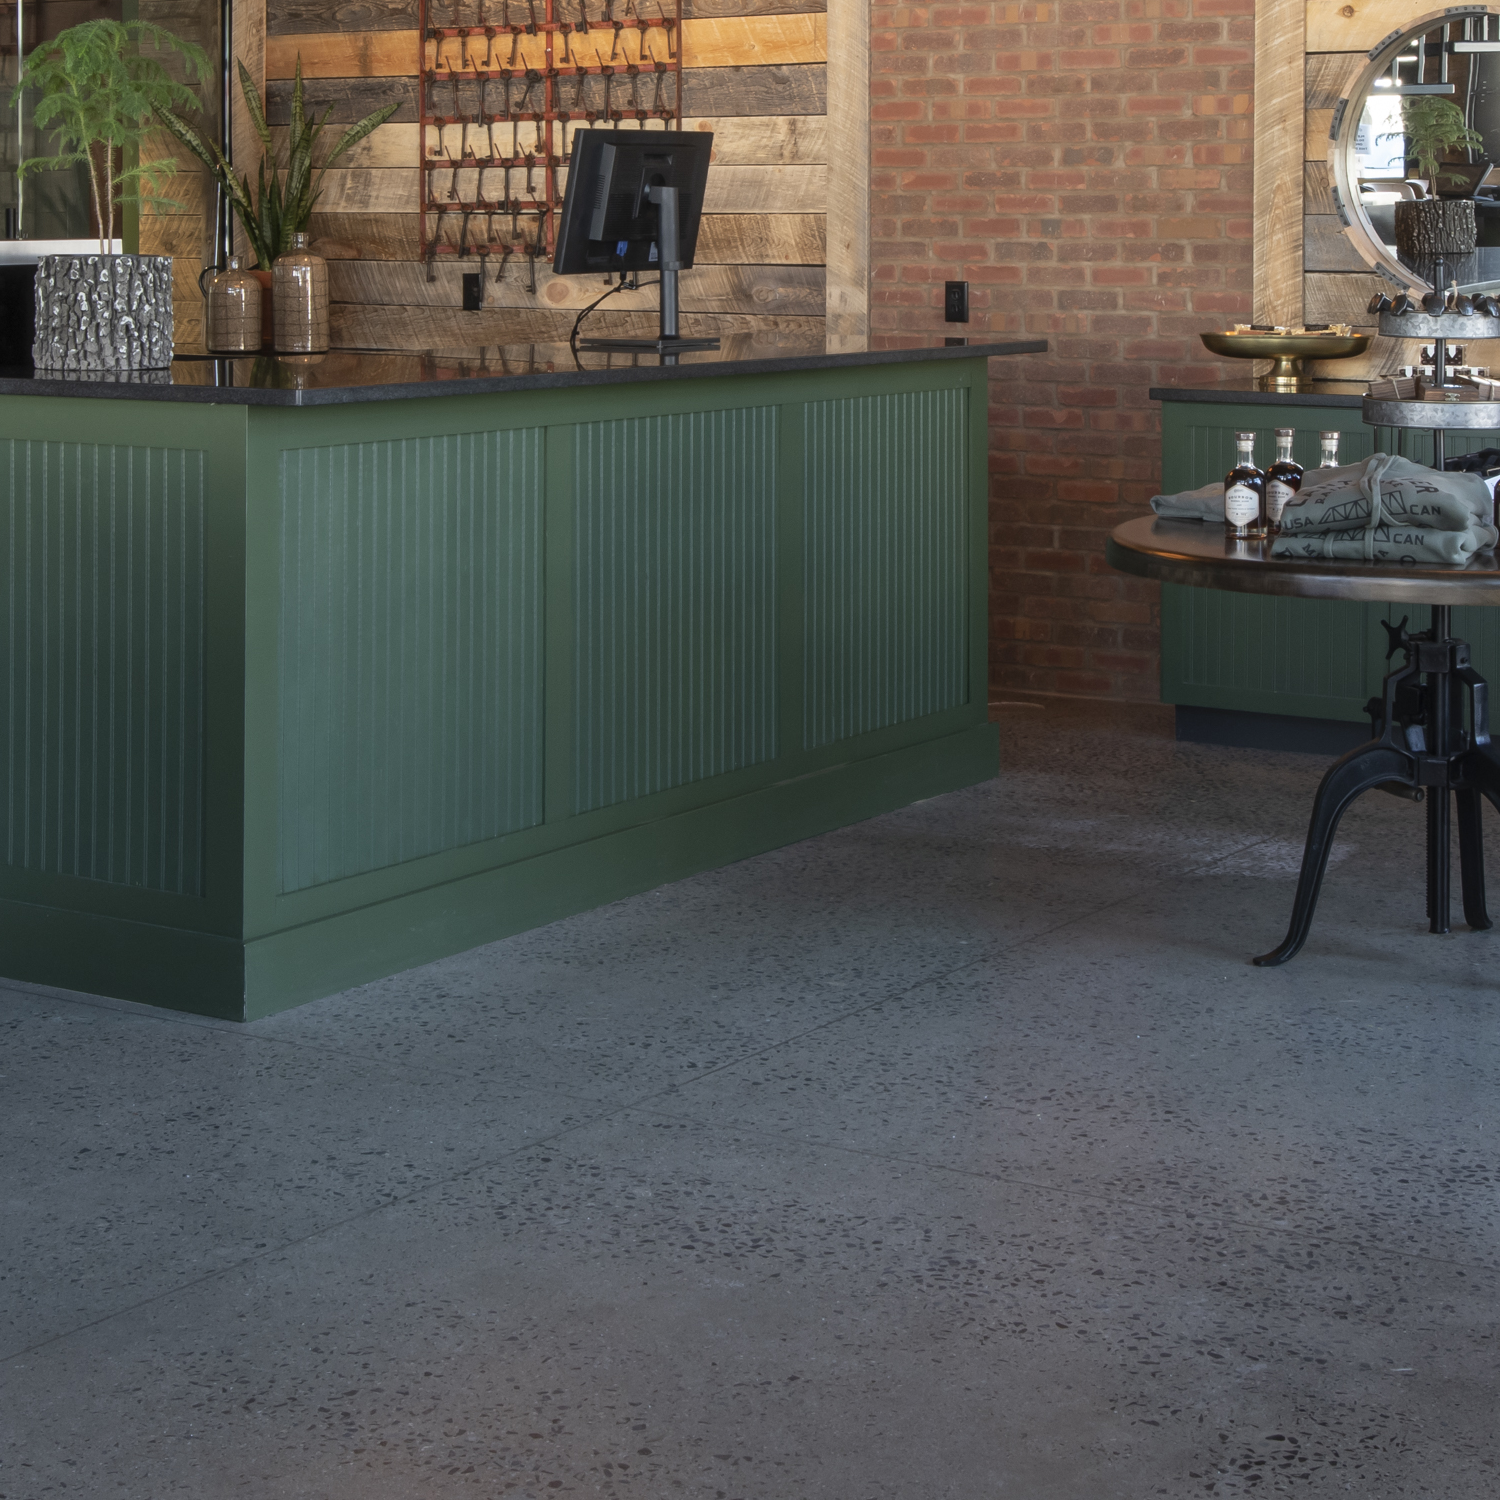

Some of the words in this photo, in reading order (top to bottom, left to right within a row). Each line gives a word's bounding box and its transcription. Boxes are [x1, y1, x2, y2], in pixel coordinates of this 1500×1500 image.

[1284, 516, 1314, 530] USA
[1409, 504, 1441, 516] CAN
[1393, 533, 1425, 545] CAN
